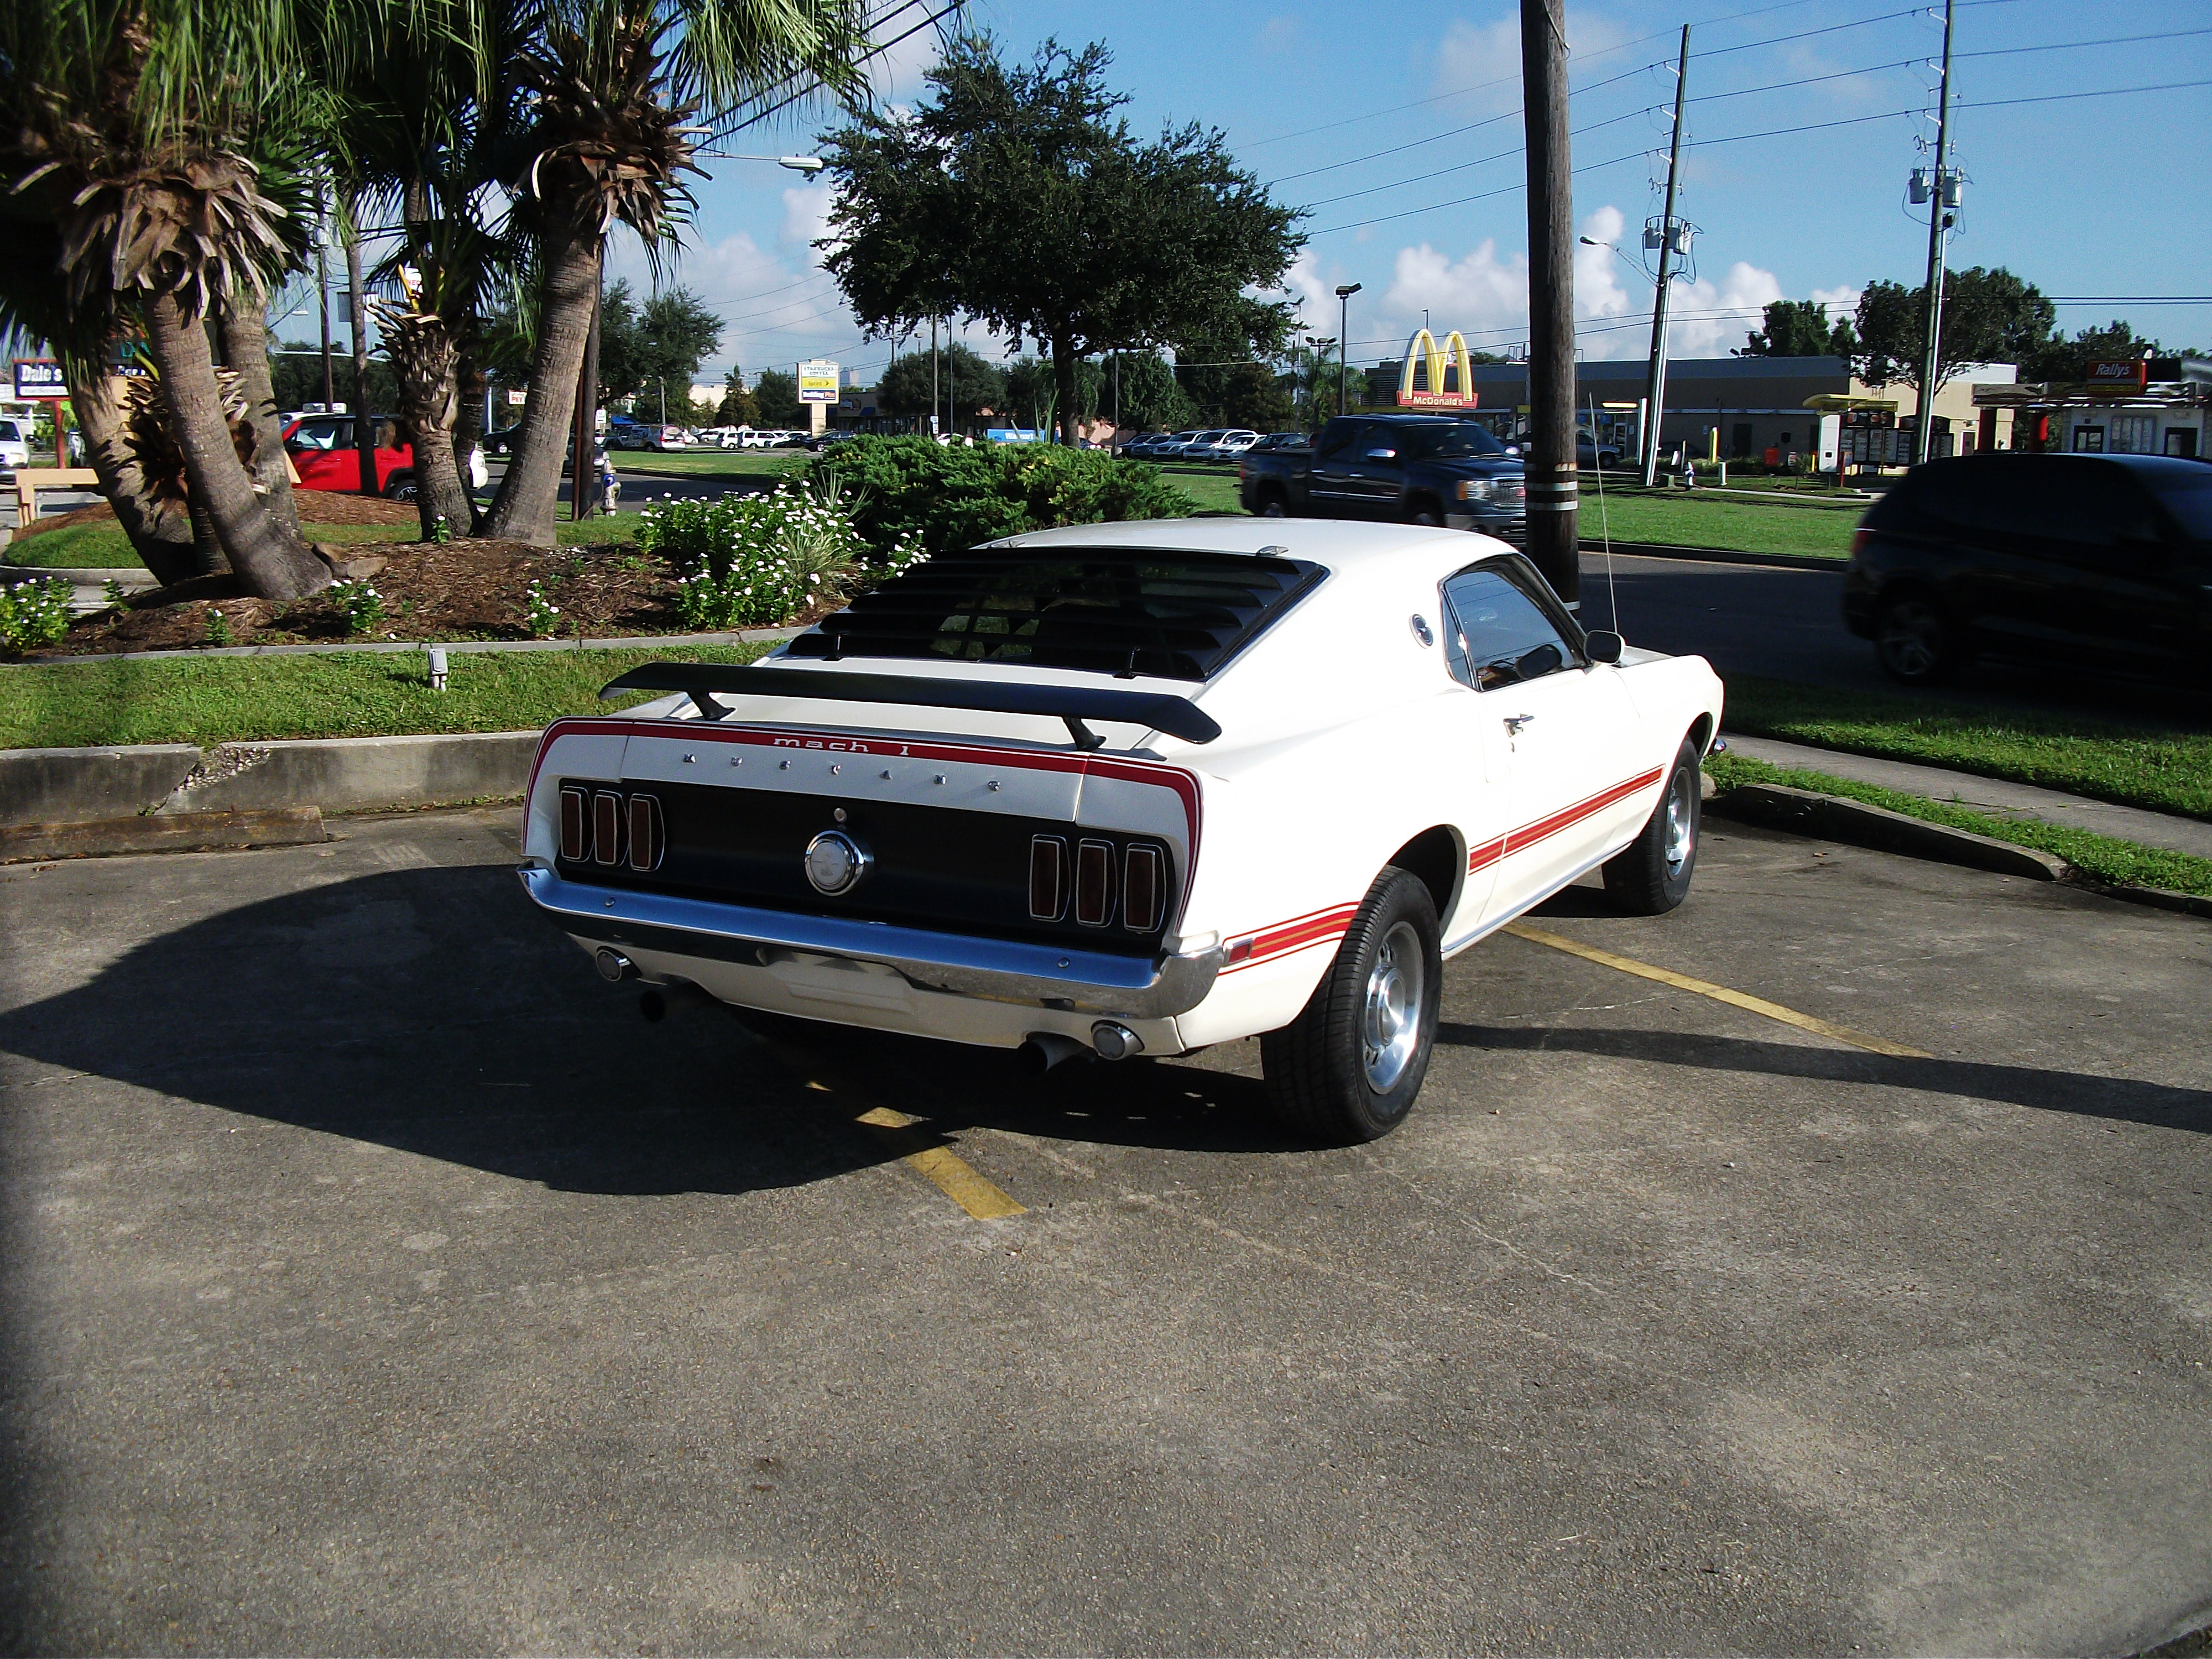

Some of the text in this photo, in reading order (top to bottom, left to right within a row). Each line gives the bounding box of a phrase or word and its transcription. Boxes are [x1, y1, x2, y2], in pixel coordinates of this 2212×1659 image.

[2095, 363, 2130, 378] Rally's
[1413, 396, 1463, 406] McDonald's
[773, 738, 909, 755] mach 1
